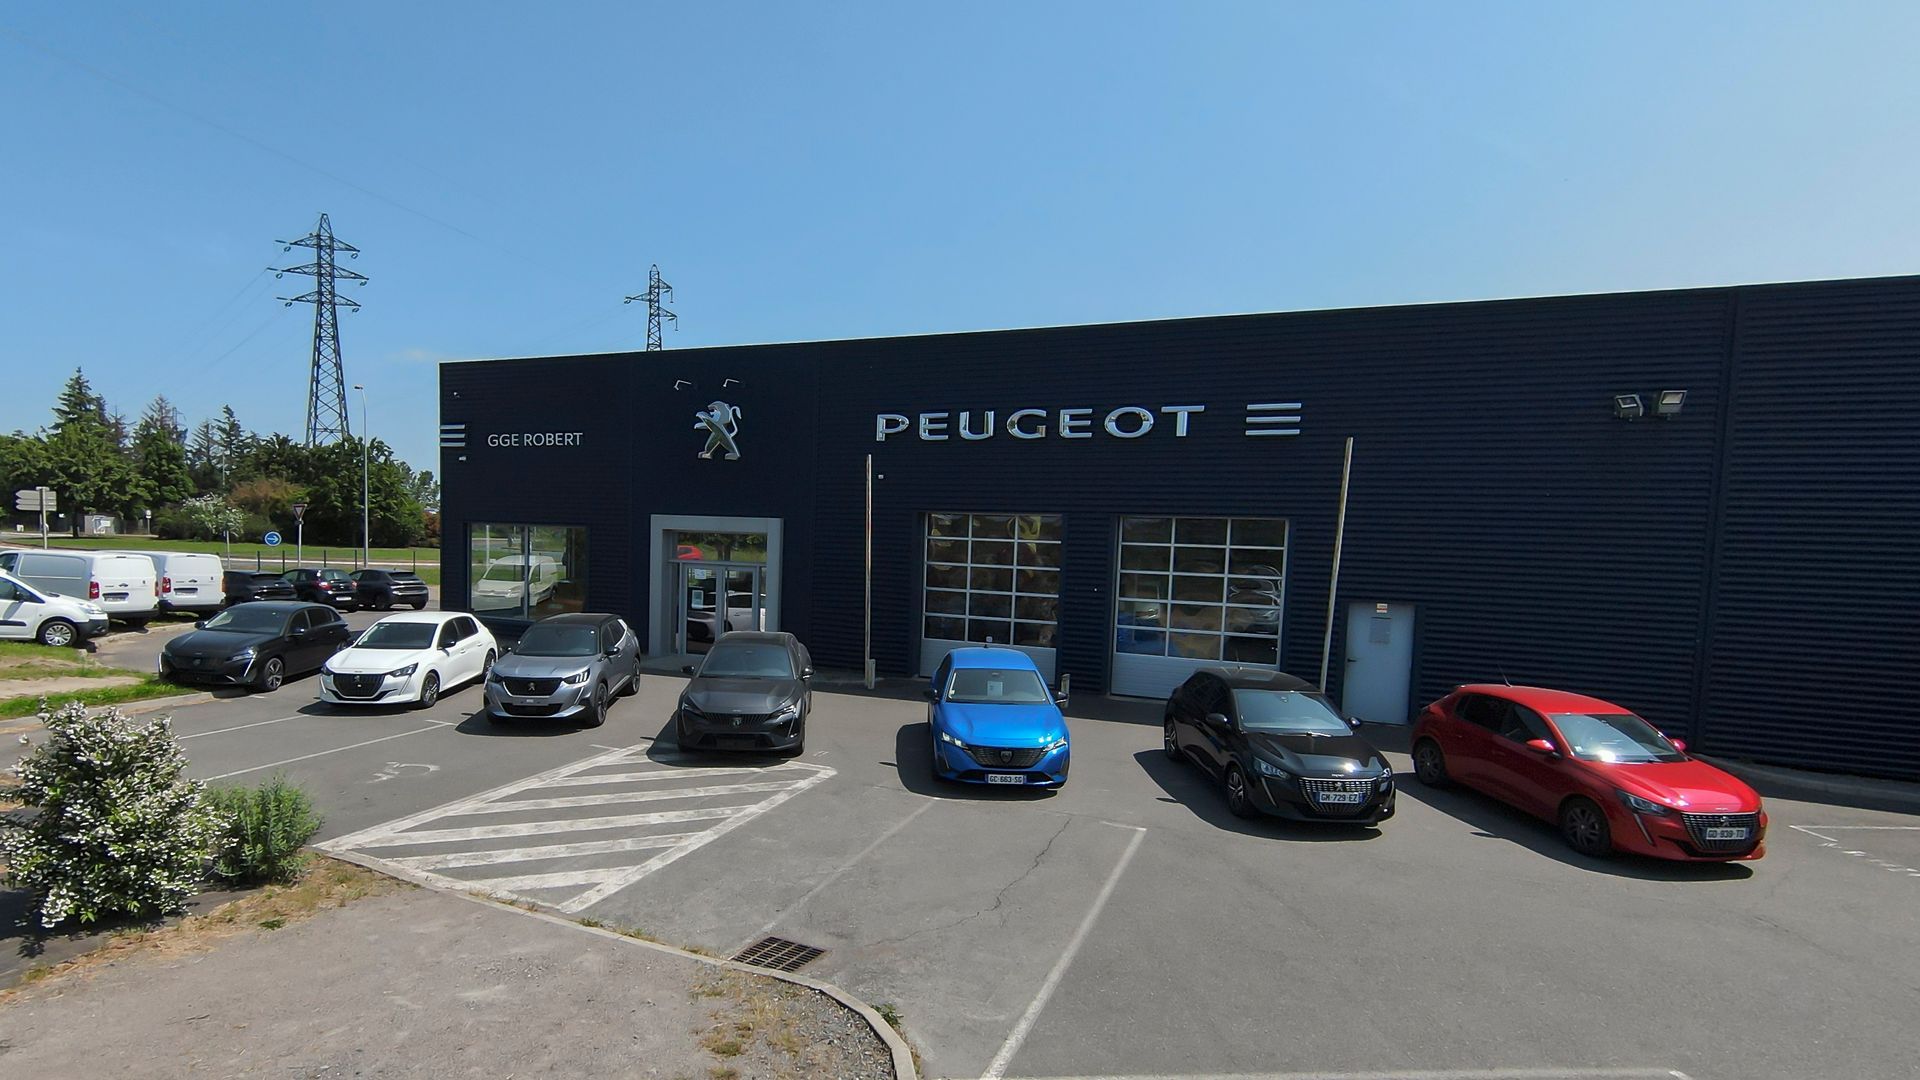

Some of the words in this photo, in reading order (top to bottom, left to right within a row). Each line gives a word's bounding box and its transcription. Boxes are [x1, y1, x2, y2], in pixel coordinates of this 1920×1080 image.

[876, 405, 1205, 441] PEUGEOT
[487, 433, 520, 447] GGE
[523, 432, 584, 447] ROBERT
